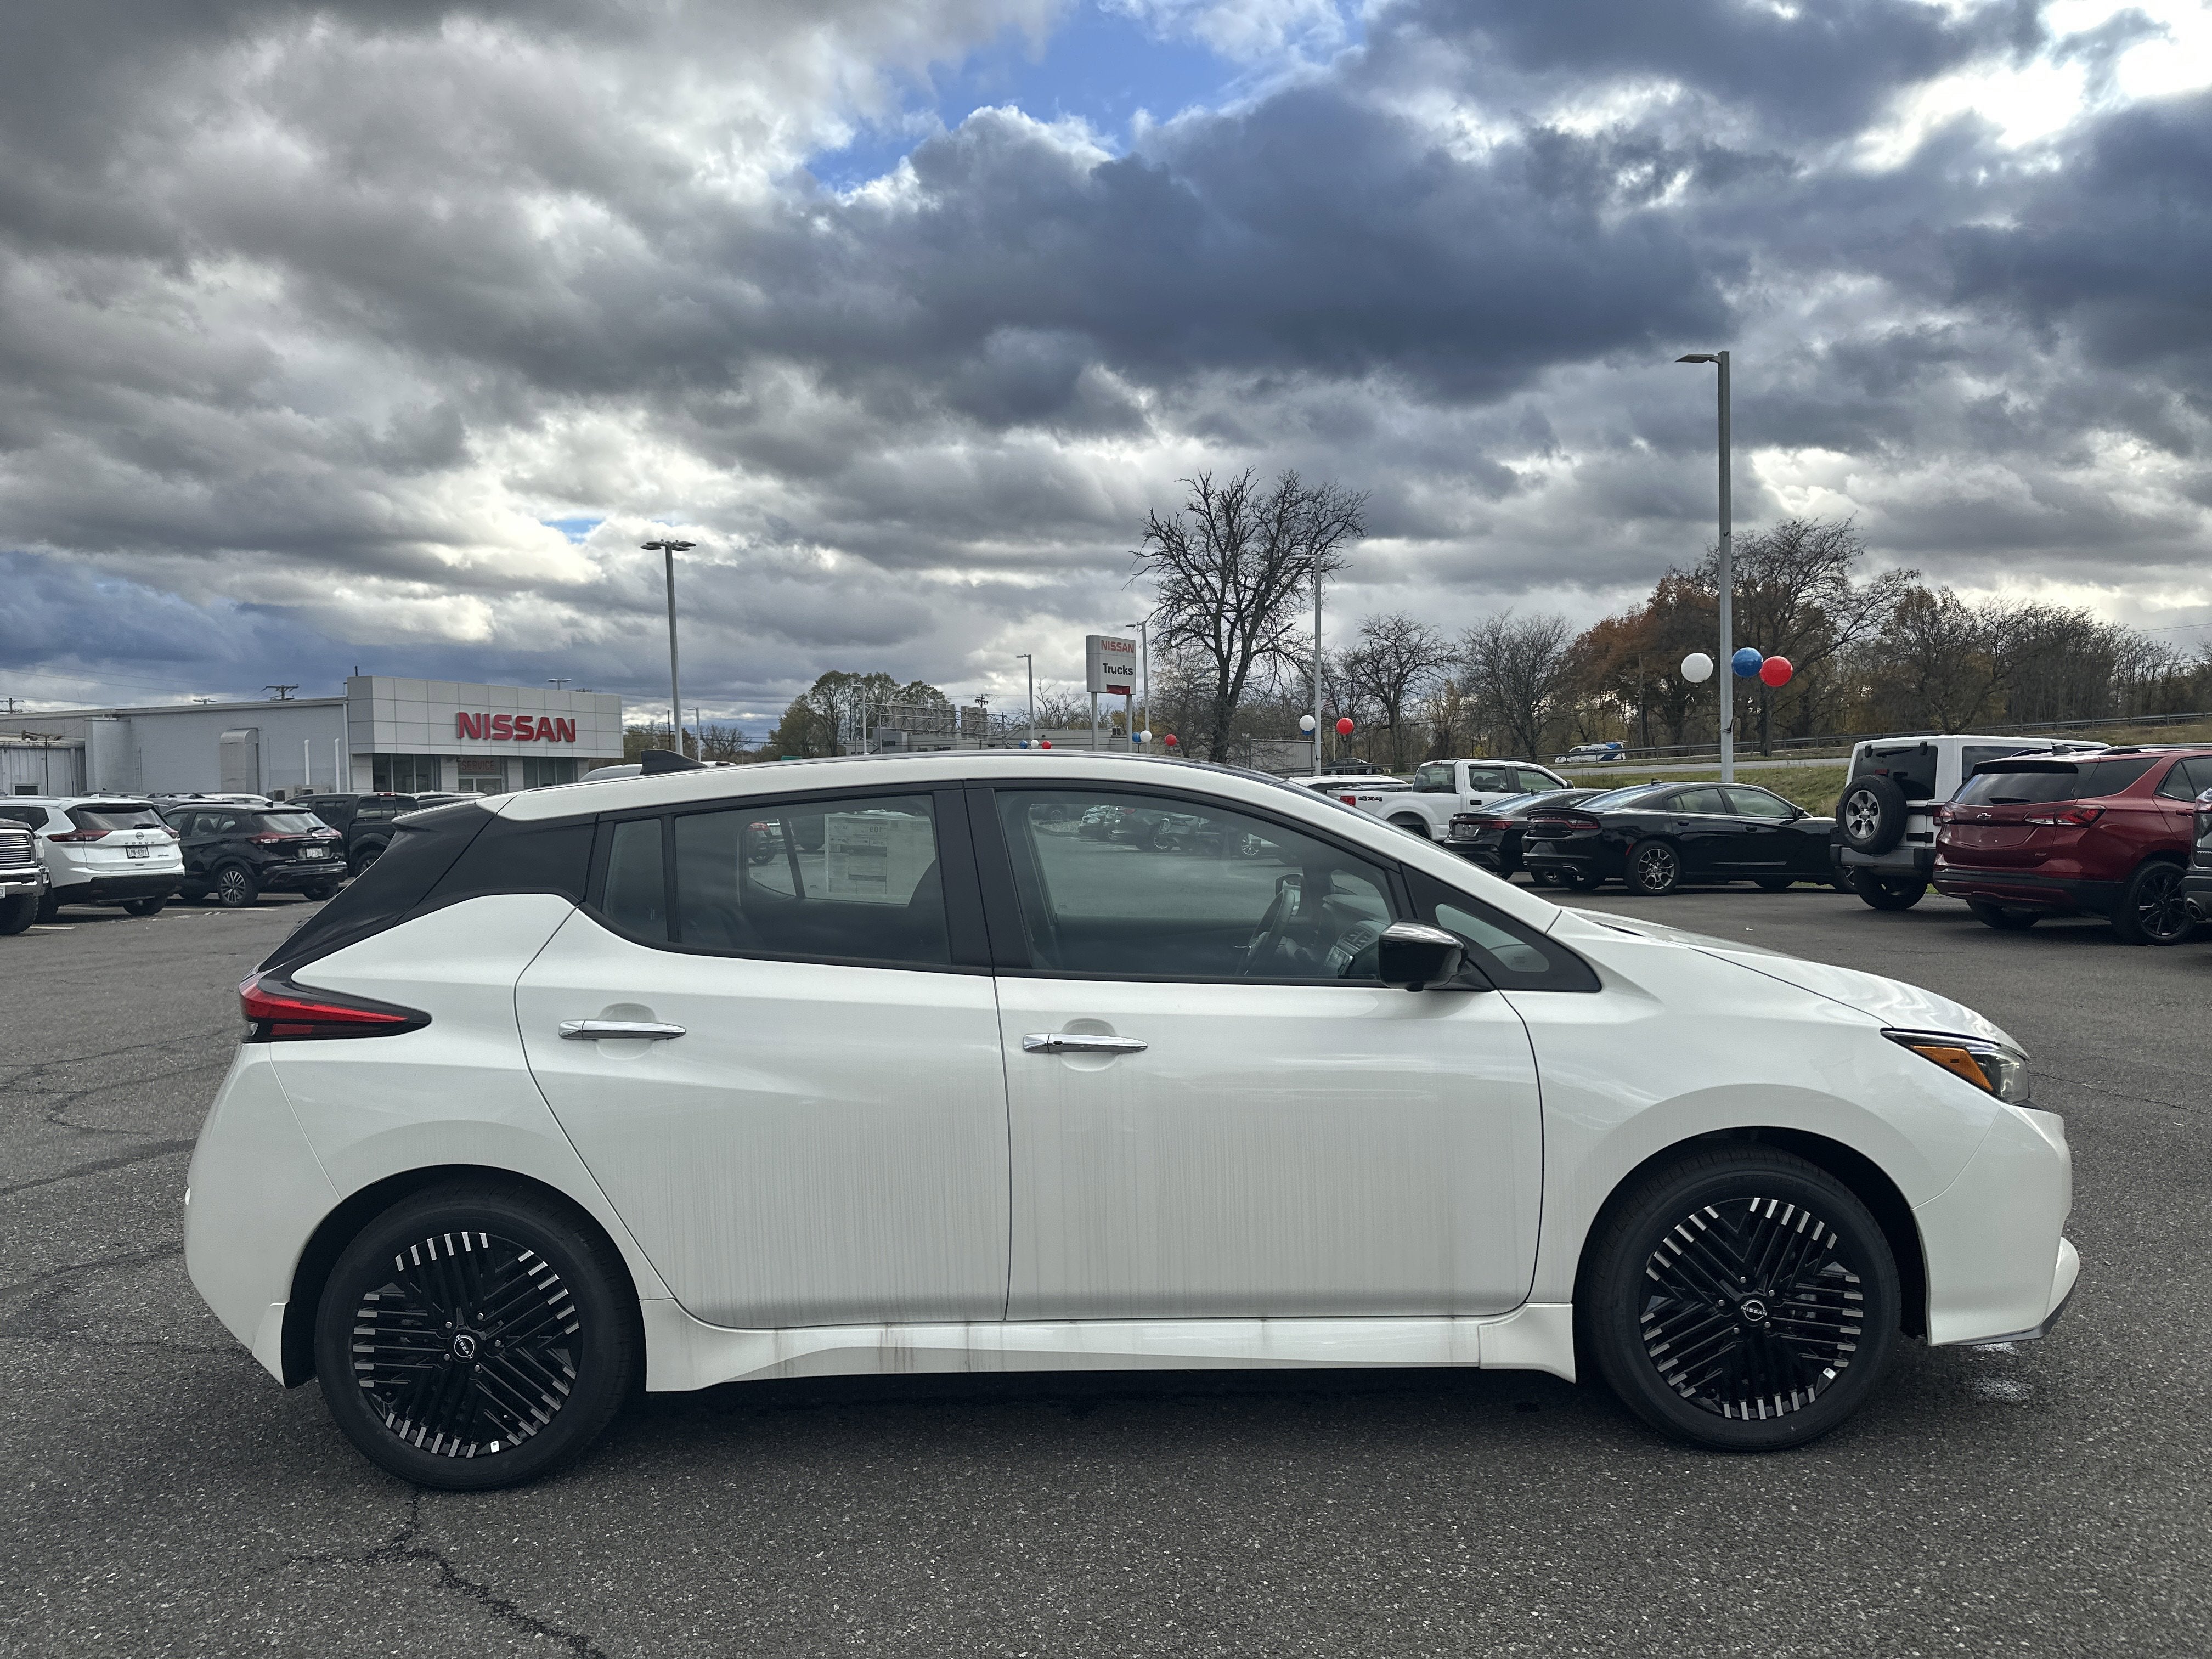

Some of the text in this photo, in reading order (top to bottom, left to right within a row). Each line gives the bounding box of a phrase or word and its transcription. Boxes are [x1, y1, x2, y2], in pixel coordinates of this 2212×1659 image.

[1101, 640, 1134, 653] NISSAN
[1103, 663, 1133, 676] Trucks
[457, 712, 576, 742] NISSAN
[462, 760, 495, 771] SERVICE
[1741, 1306, 1768, 1316] NISSAN
[456, 1334, 473, 1359] NISSAN
